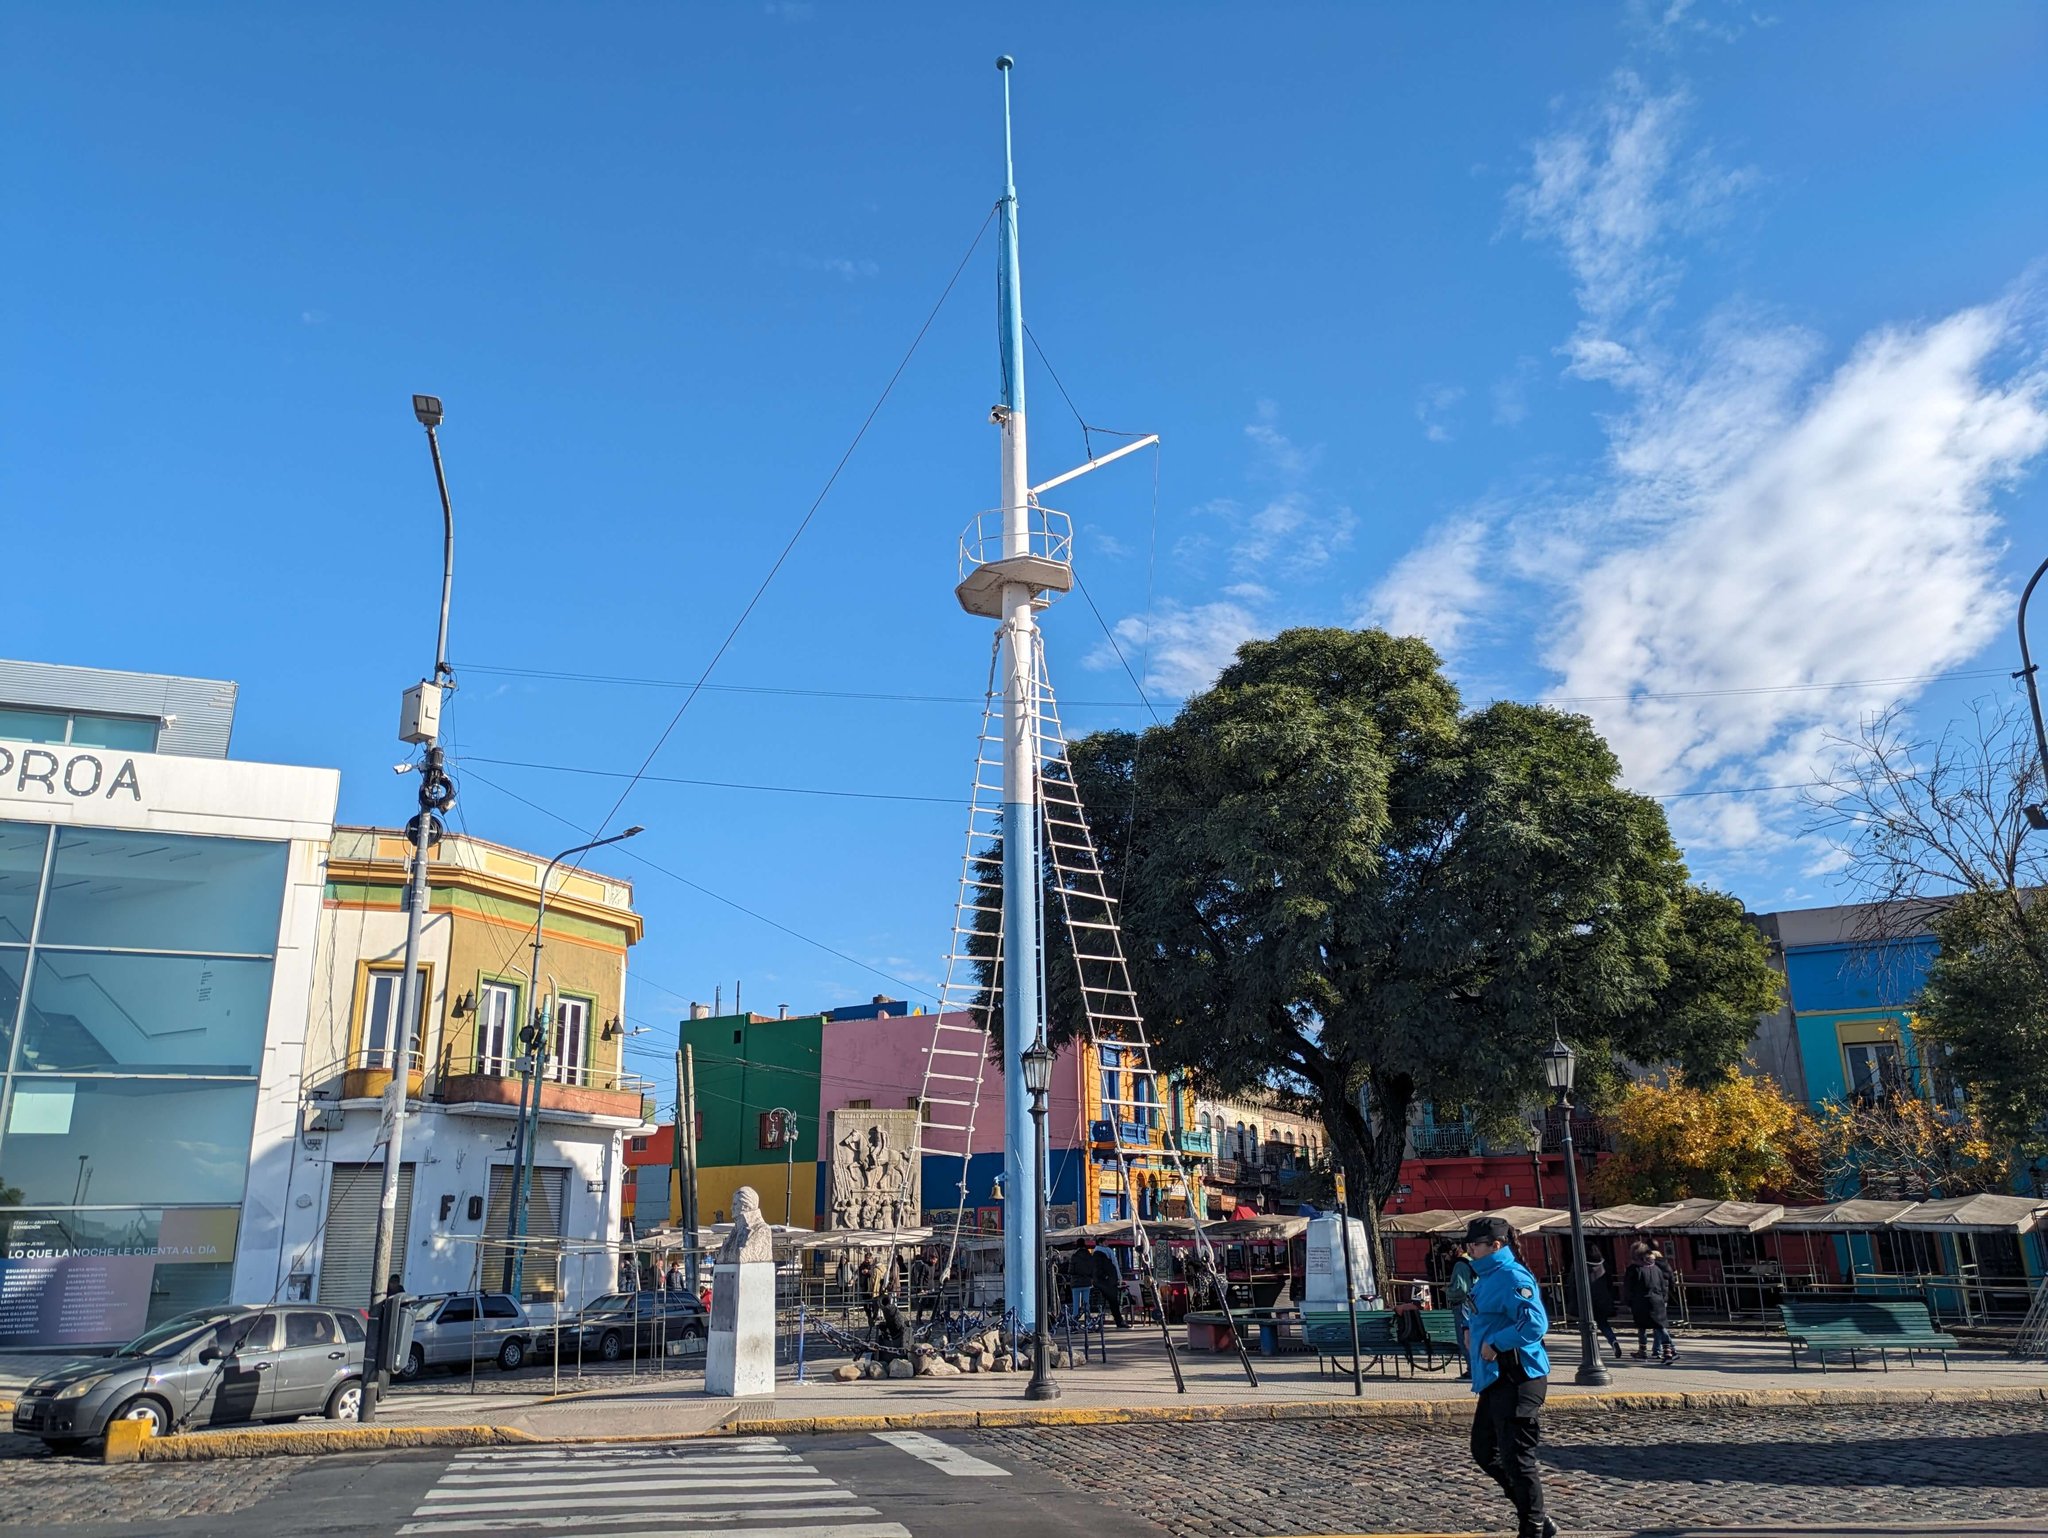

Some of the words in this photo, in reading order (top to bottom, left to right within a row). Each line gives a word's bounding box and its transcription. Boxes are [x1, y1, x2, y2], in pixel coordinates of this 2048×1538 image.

[8, 1249, 24, 1260] LO
[26, 1249, 53, 1260] QUE
[55, 1248, 70, 1258] LA
[72, 1247, 115, 1257] NOCHE
[117, 1247, 131, 1257] LE
[133, 1246, 179, 1256] CUENTA
[182, 1245, 196, 1255] AL
[198, 1244, 217, 1255] DÍA
